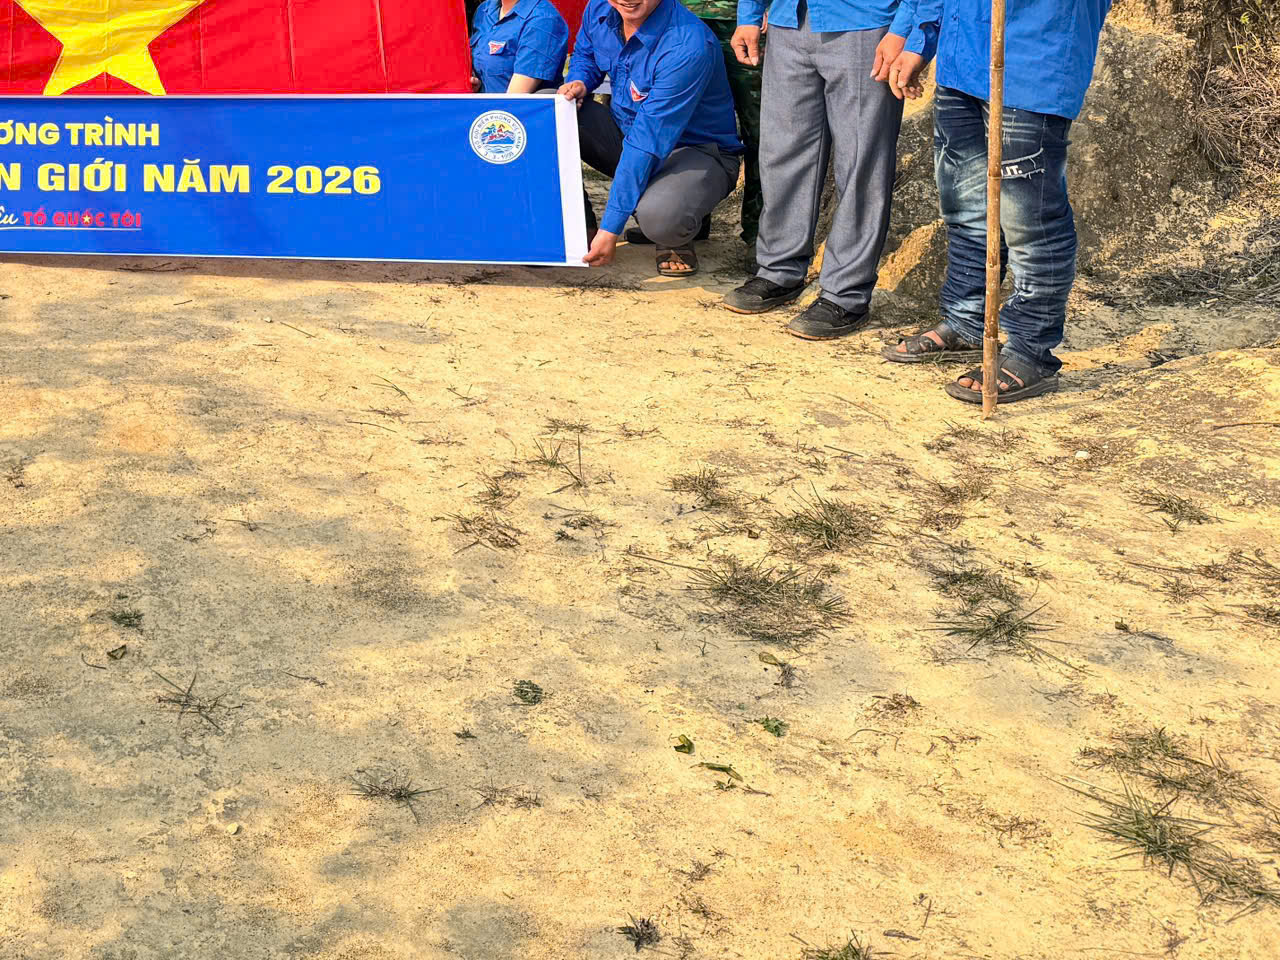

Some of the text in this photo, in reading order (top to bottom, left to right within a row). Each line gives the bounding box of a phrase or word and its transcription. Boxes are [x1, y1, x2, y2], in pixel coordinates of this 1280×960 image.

[64, 115, 160, 146] TRÌNH
[37, 157, 127, 192] GIỚI
[143, 158, 250, 193] NĂM
[266, 165, 381, 194] 2026
[22, 206, 48, 226] TỔ
[52, 208, 105, 227] QUỐC
[110, 210, 142, 227] TÔI
